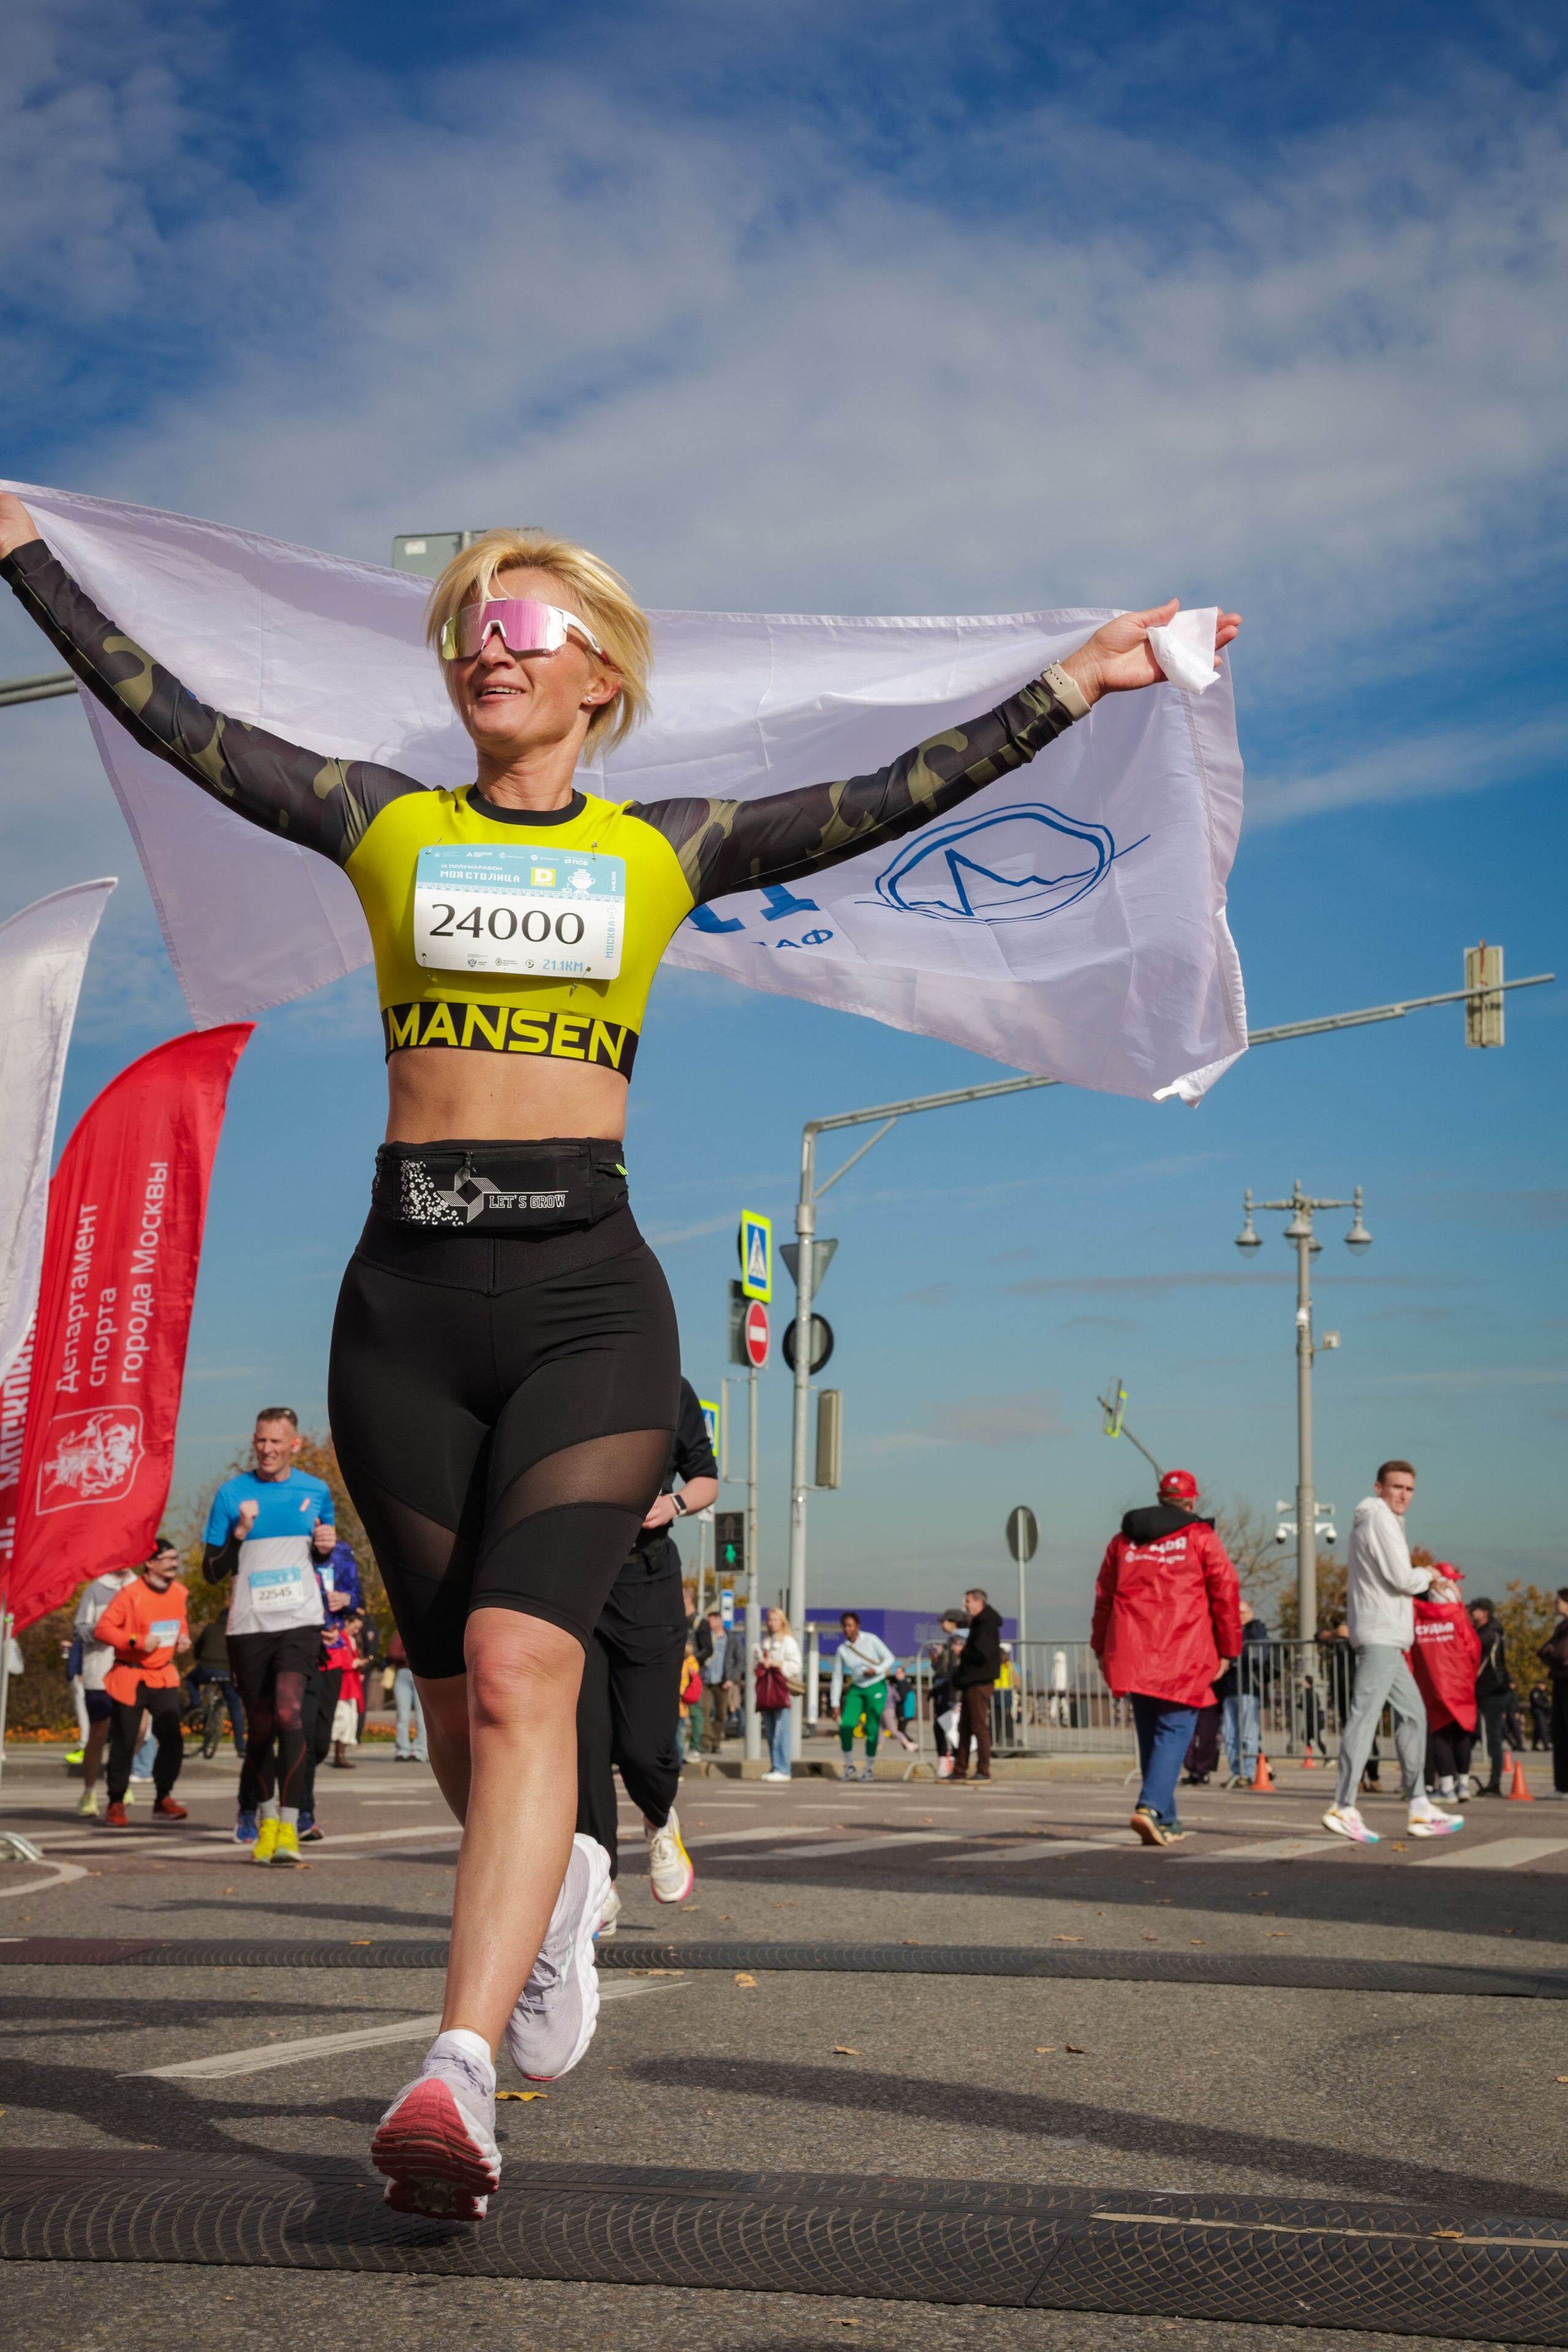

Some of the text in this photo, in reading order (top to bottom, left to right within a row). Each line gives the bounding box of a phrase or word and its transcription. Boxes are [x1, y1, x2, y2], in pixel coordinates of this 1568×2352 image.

[466, 872, 520, 883] СТОЛИЦА
[429, 903, 585, 944] 24000
[605, 921, 616, 959] МОСКВА
[388, 1003, 628, 1069] MANSEN
[489, 1194, 566, 1208] LET'S GROW
[56, 1204, 99, 1393] Департамент
[121, 1162, 168, 1383] города Москвы
[89, 1287, 118, 1387] спорта
